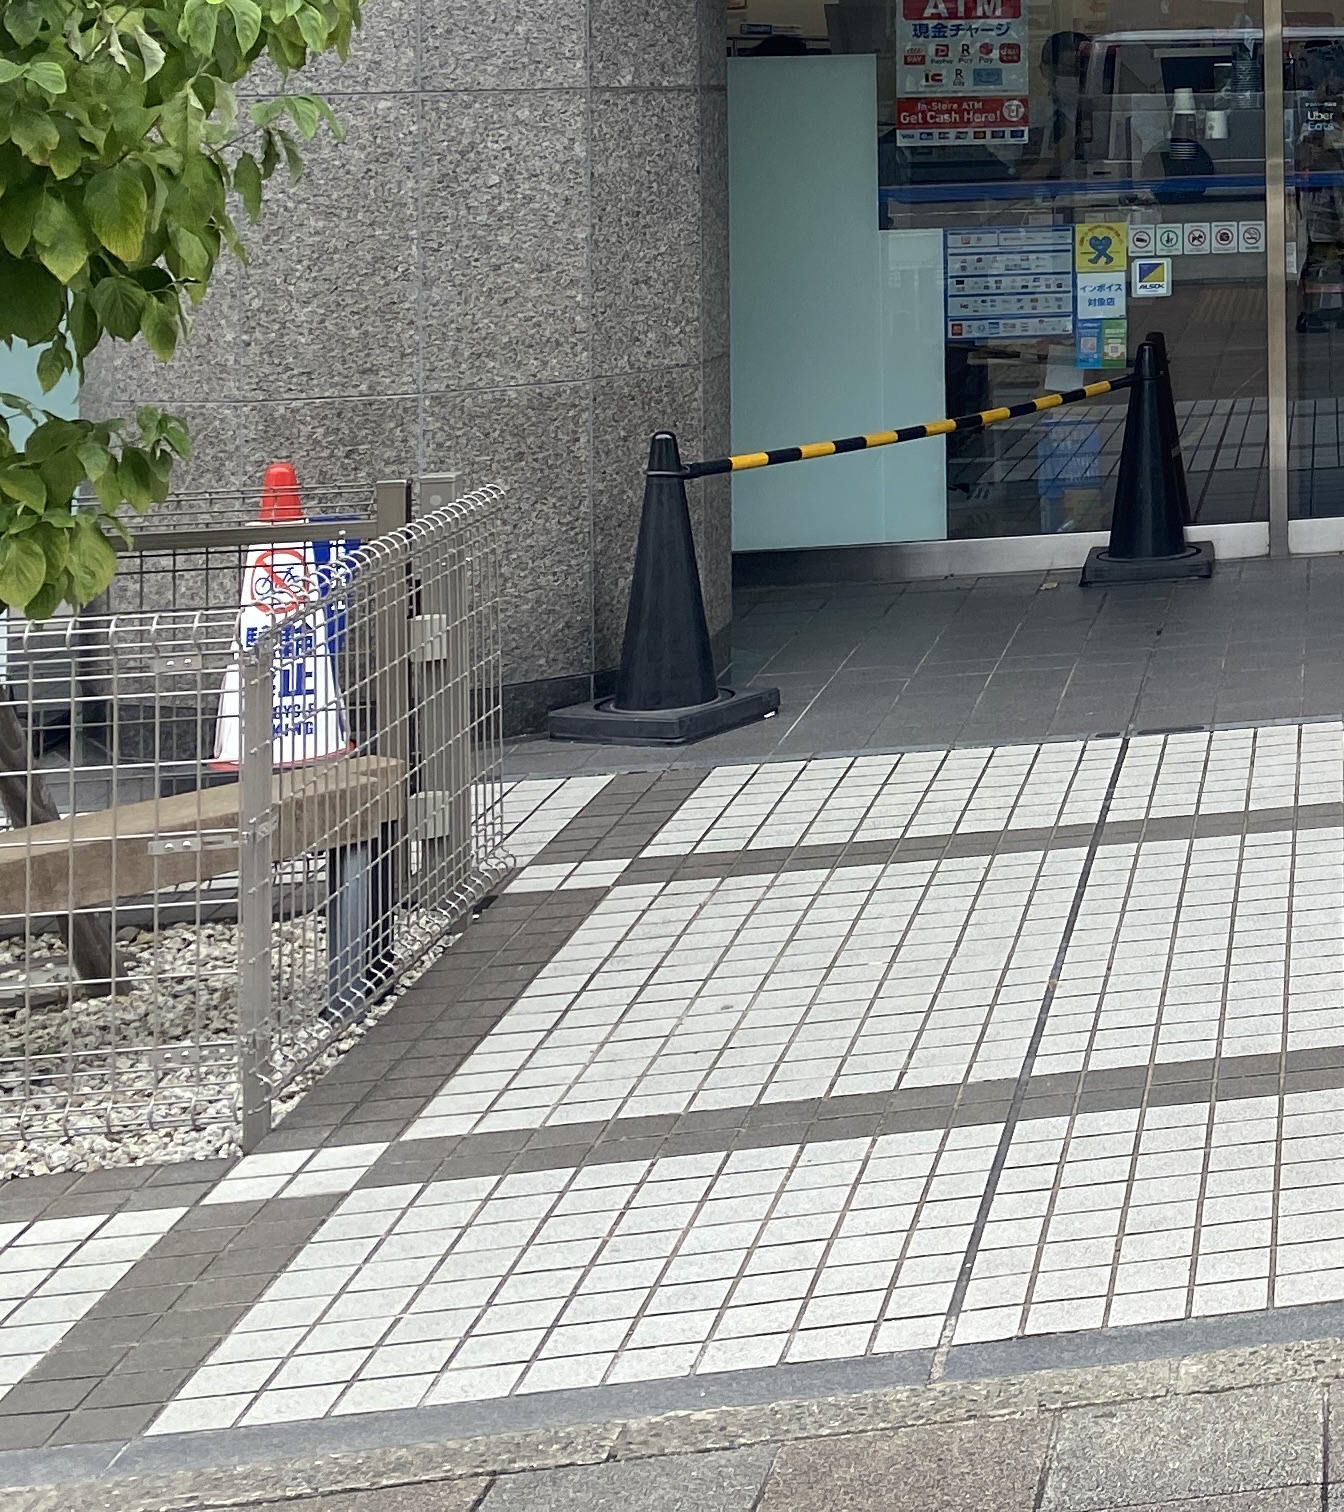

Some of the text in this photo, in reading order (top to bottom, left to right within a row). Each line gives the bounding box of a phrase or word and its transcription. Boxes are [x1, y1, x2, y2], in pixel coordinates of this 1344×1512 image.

[911, 22, 1013, 39] 現金チャージ
[961, 100, 983, 110] ATM
[900, 109, 1001, 124] Get Cash Here!
[1307, 110, 1334, 121] Uber
[1307, 121, 1335, 131] Eats
[1079, 282, 1123, 293] インボイス
